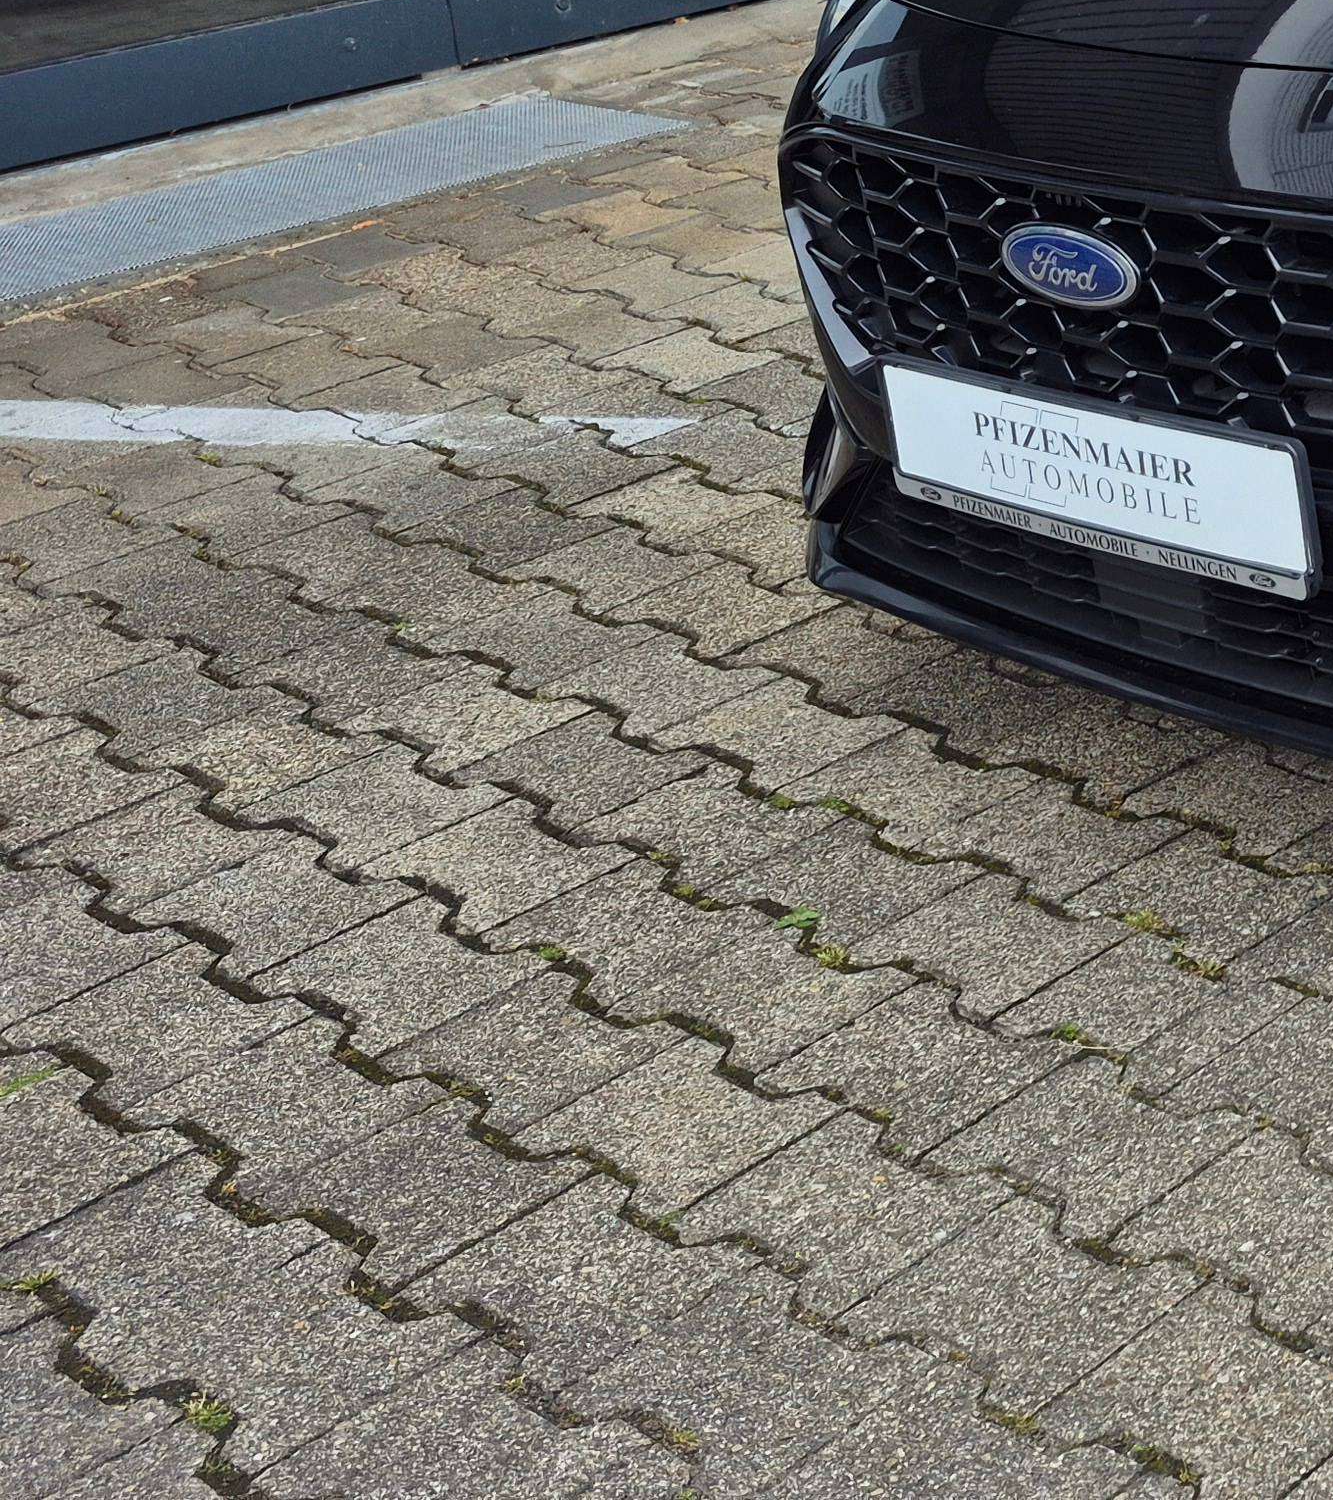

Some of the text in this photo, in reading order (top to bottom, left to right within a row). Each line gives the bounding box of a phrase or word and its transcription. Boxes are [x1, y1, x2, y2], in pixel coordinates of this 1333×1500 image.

[1027, 242, 1099, 293] Ford
[973, 410, 1196, 487] PFIZENMAIER
[980, 449, 1201, 525] AUTOMOBILE
[952, 494, 1032, 529] PFIZENMAIER
[1049, 523, 1139, 557] AUTOMOBILE
[1158, 549, 1238, 581] NELLINGEN
